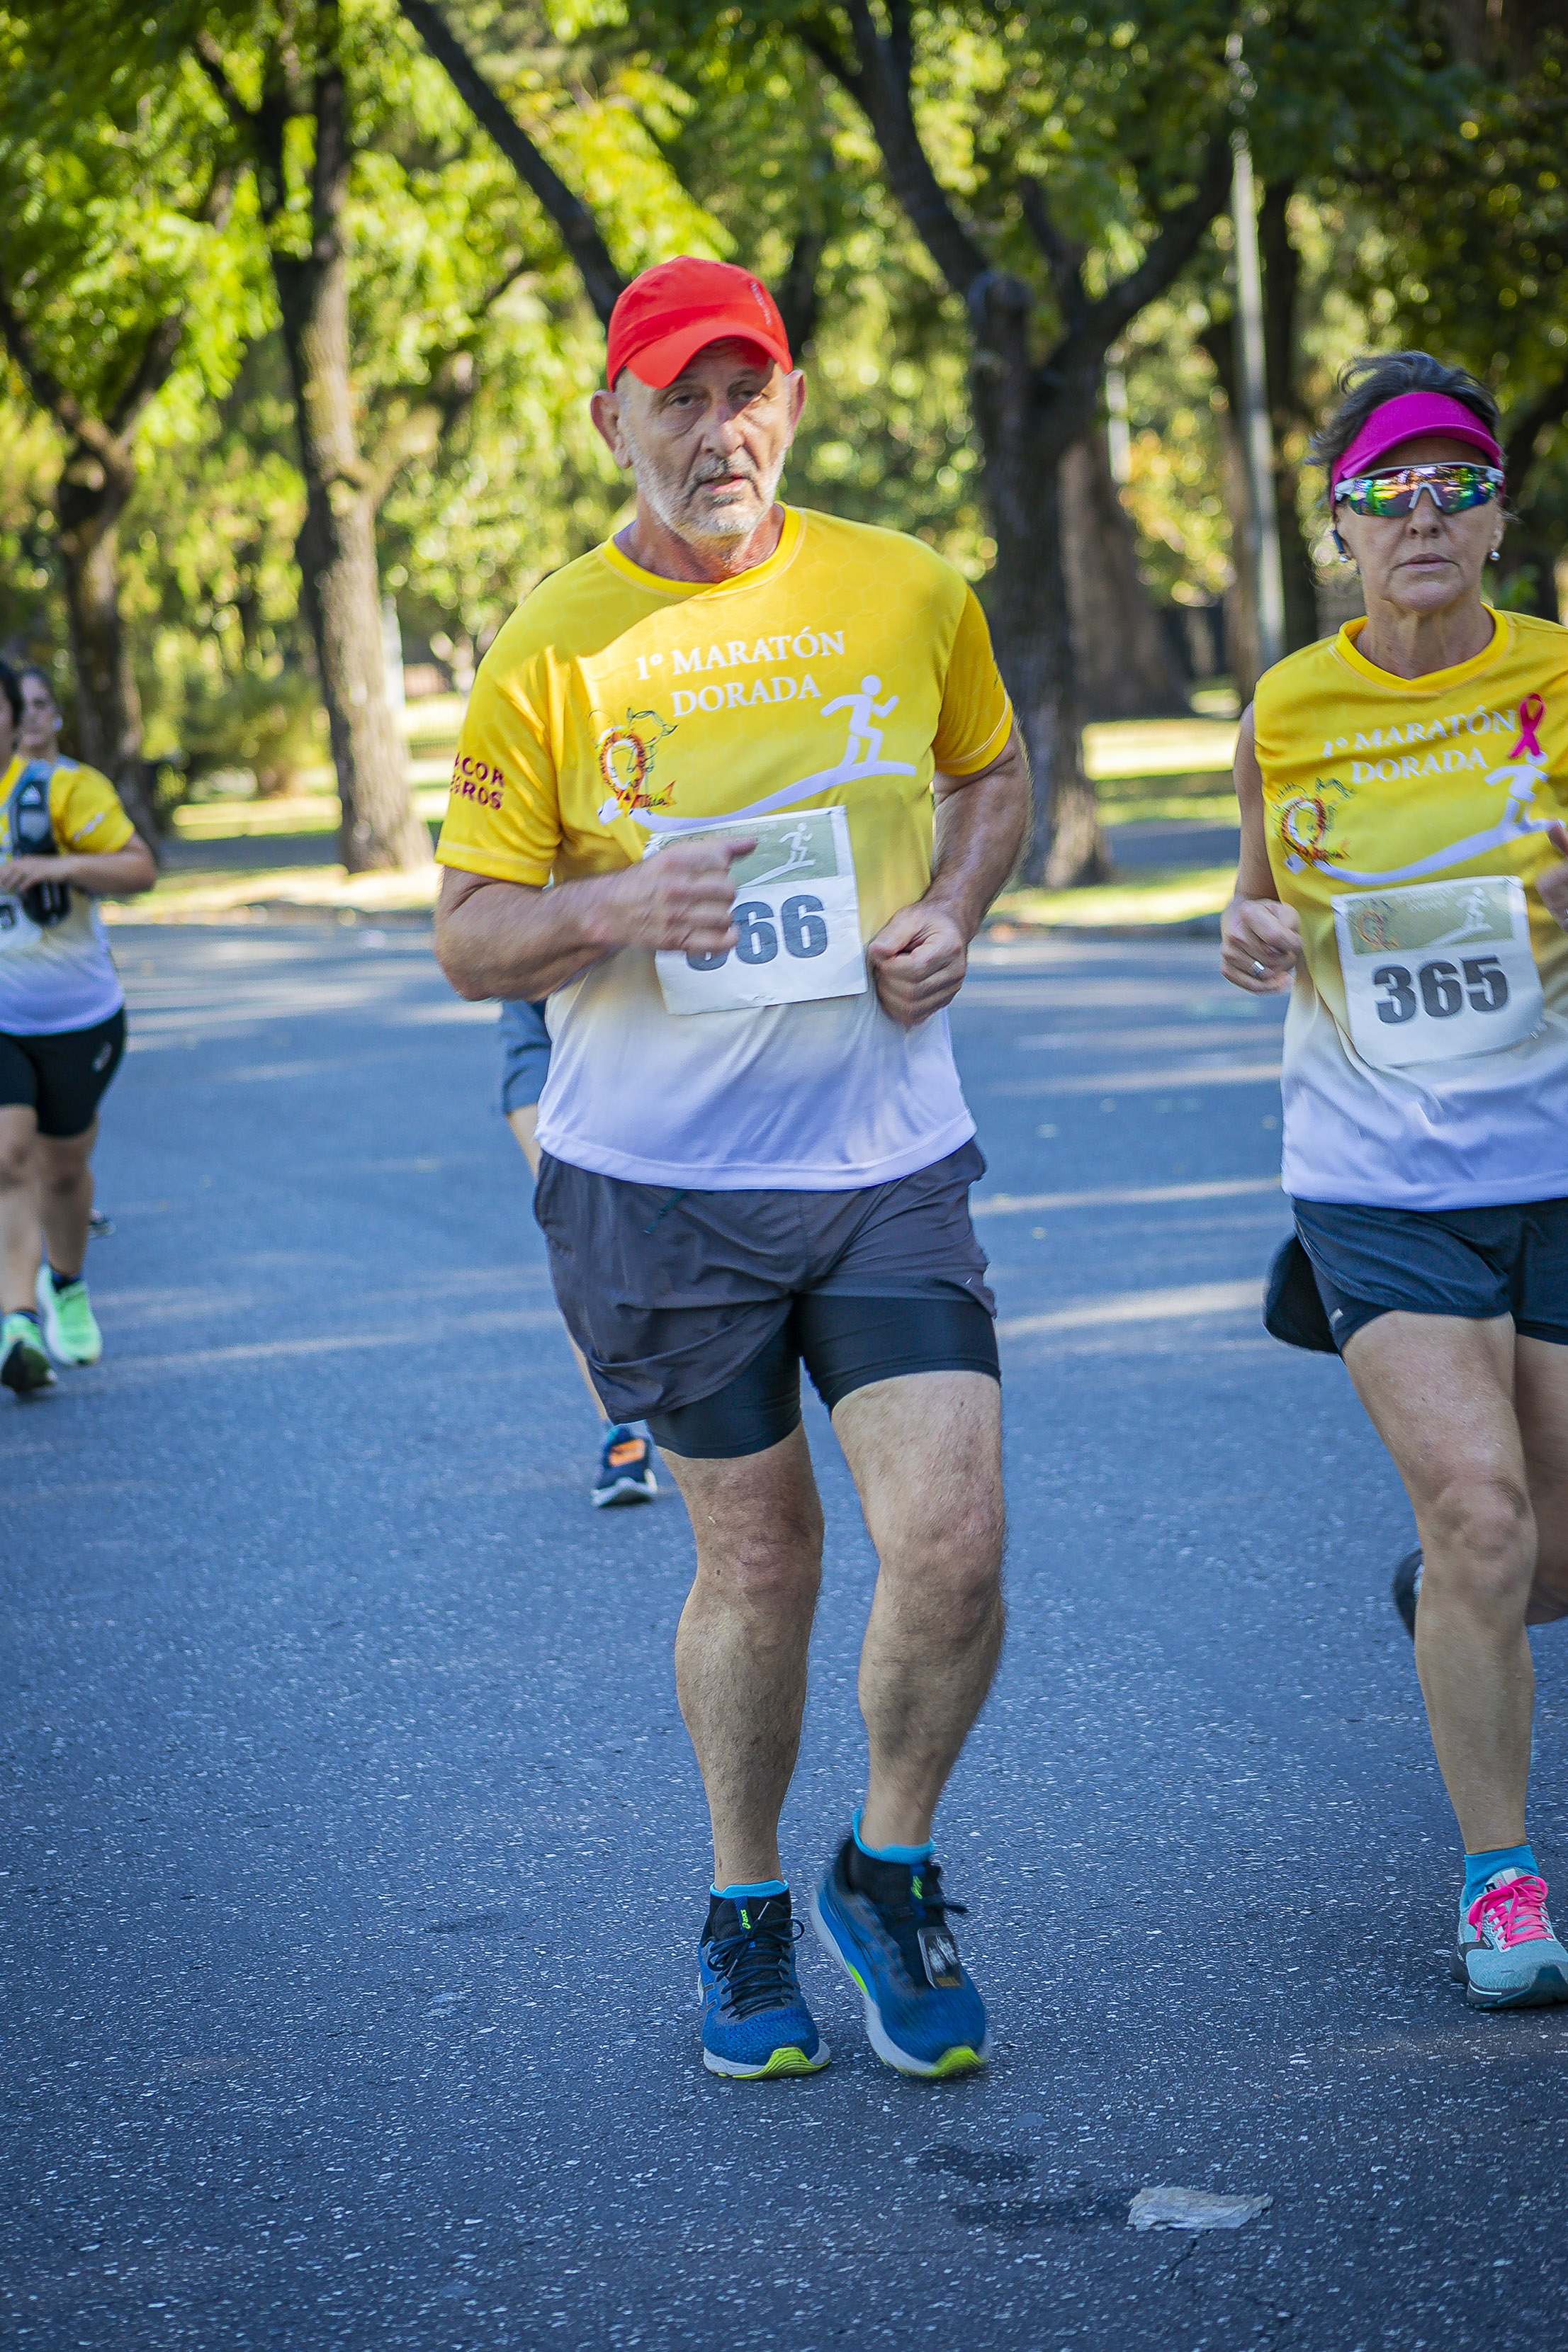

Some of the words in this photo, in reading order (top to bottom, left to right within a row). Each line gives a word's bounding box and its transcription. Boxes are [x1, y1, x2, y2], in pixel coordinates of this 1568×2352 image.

[670, 626, 845, 675] MARATÓN
[670, 674, 822, 717] DORADA
[1354, 704, 1516, 751] MARATÓN
[1352, 747, 1488, 784] DORADA
[1373, 957, 1508, 1023] 365
